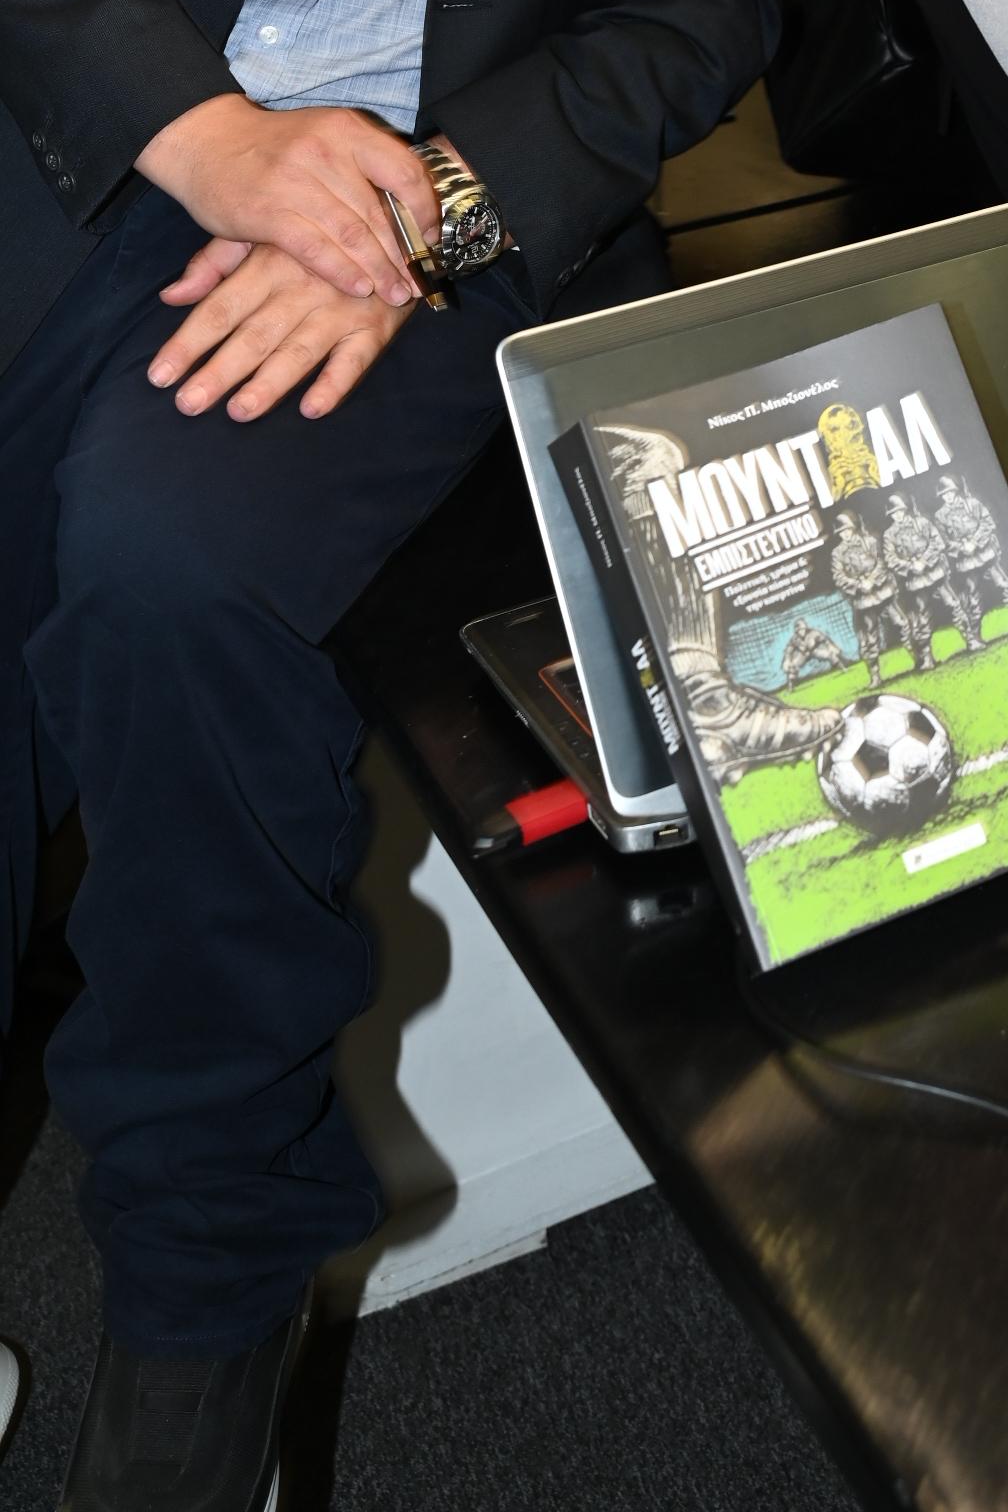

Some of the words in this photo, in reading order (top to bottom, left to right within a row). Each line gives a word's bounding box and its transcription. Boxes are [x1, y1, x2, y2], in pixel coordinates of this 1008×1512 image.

[707, 410, 745, 430] Νίκος
[761, 378, 840, 414] Μποζιονέλος
[693, 512, 820, 582] ΕΜΠΙΣΤΕΥΤΙΚΟ
